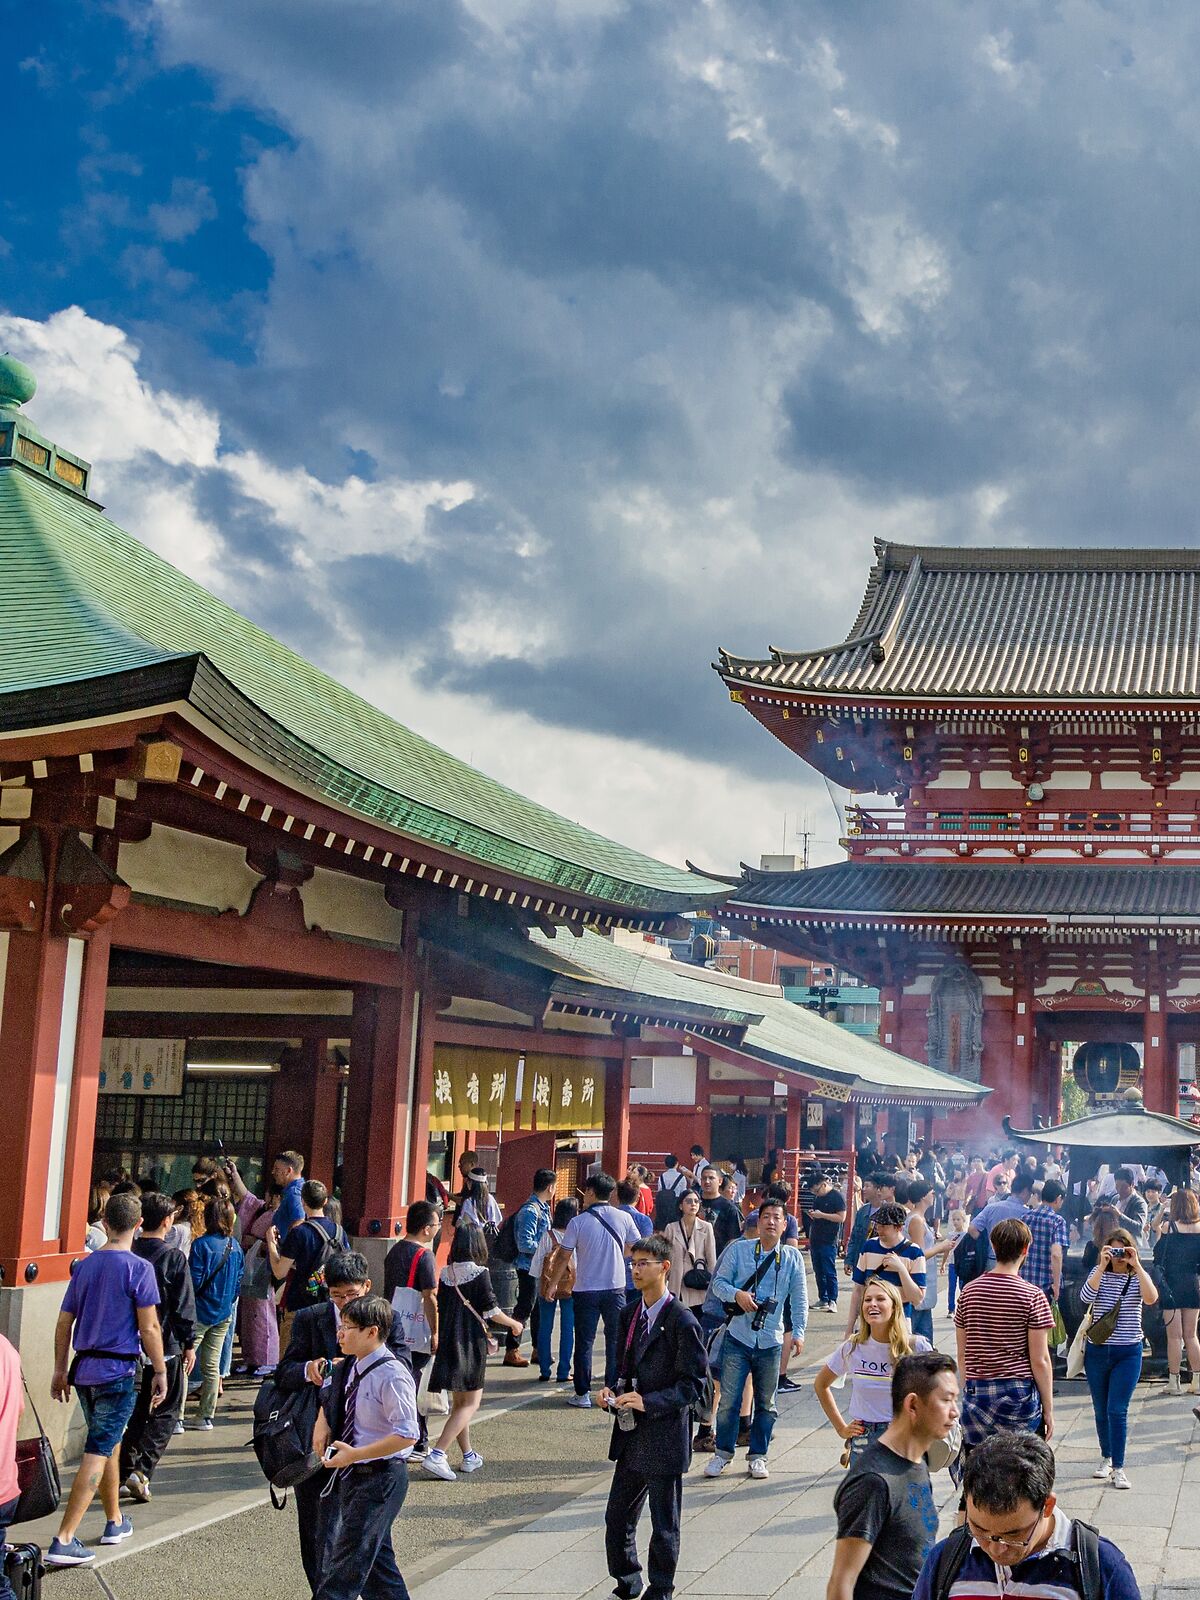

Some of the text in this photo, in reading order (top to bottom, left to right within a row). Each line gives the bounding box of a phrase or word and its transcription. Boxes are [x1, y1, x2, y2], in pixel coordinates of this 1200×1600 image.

[536, 1075, 595, 1107] 授香所
[861, 1359, 888, 1373] TOK
